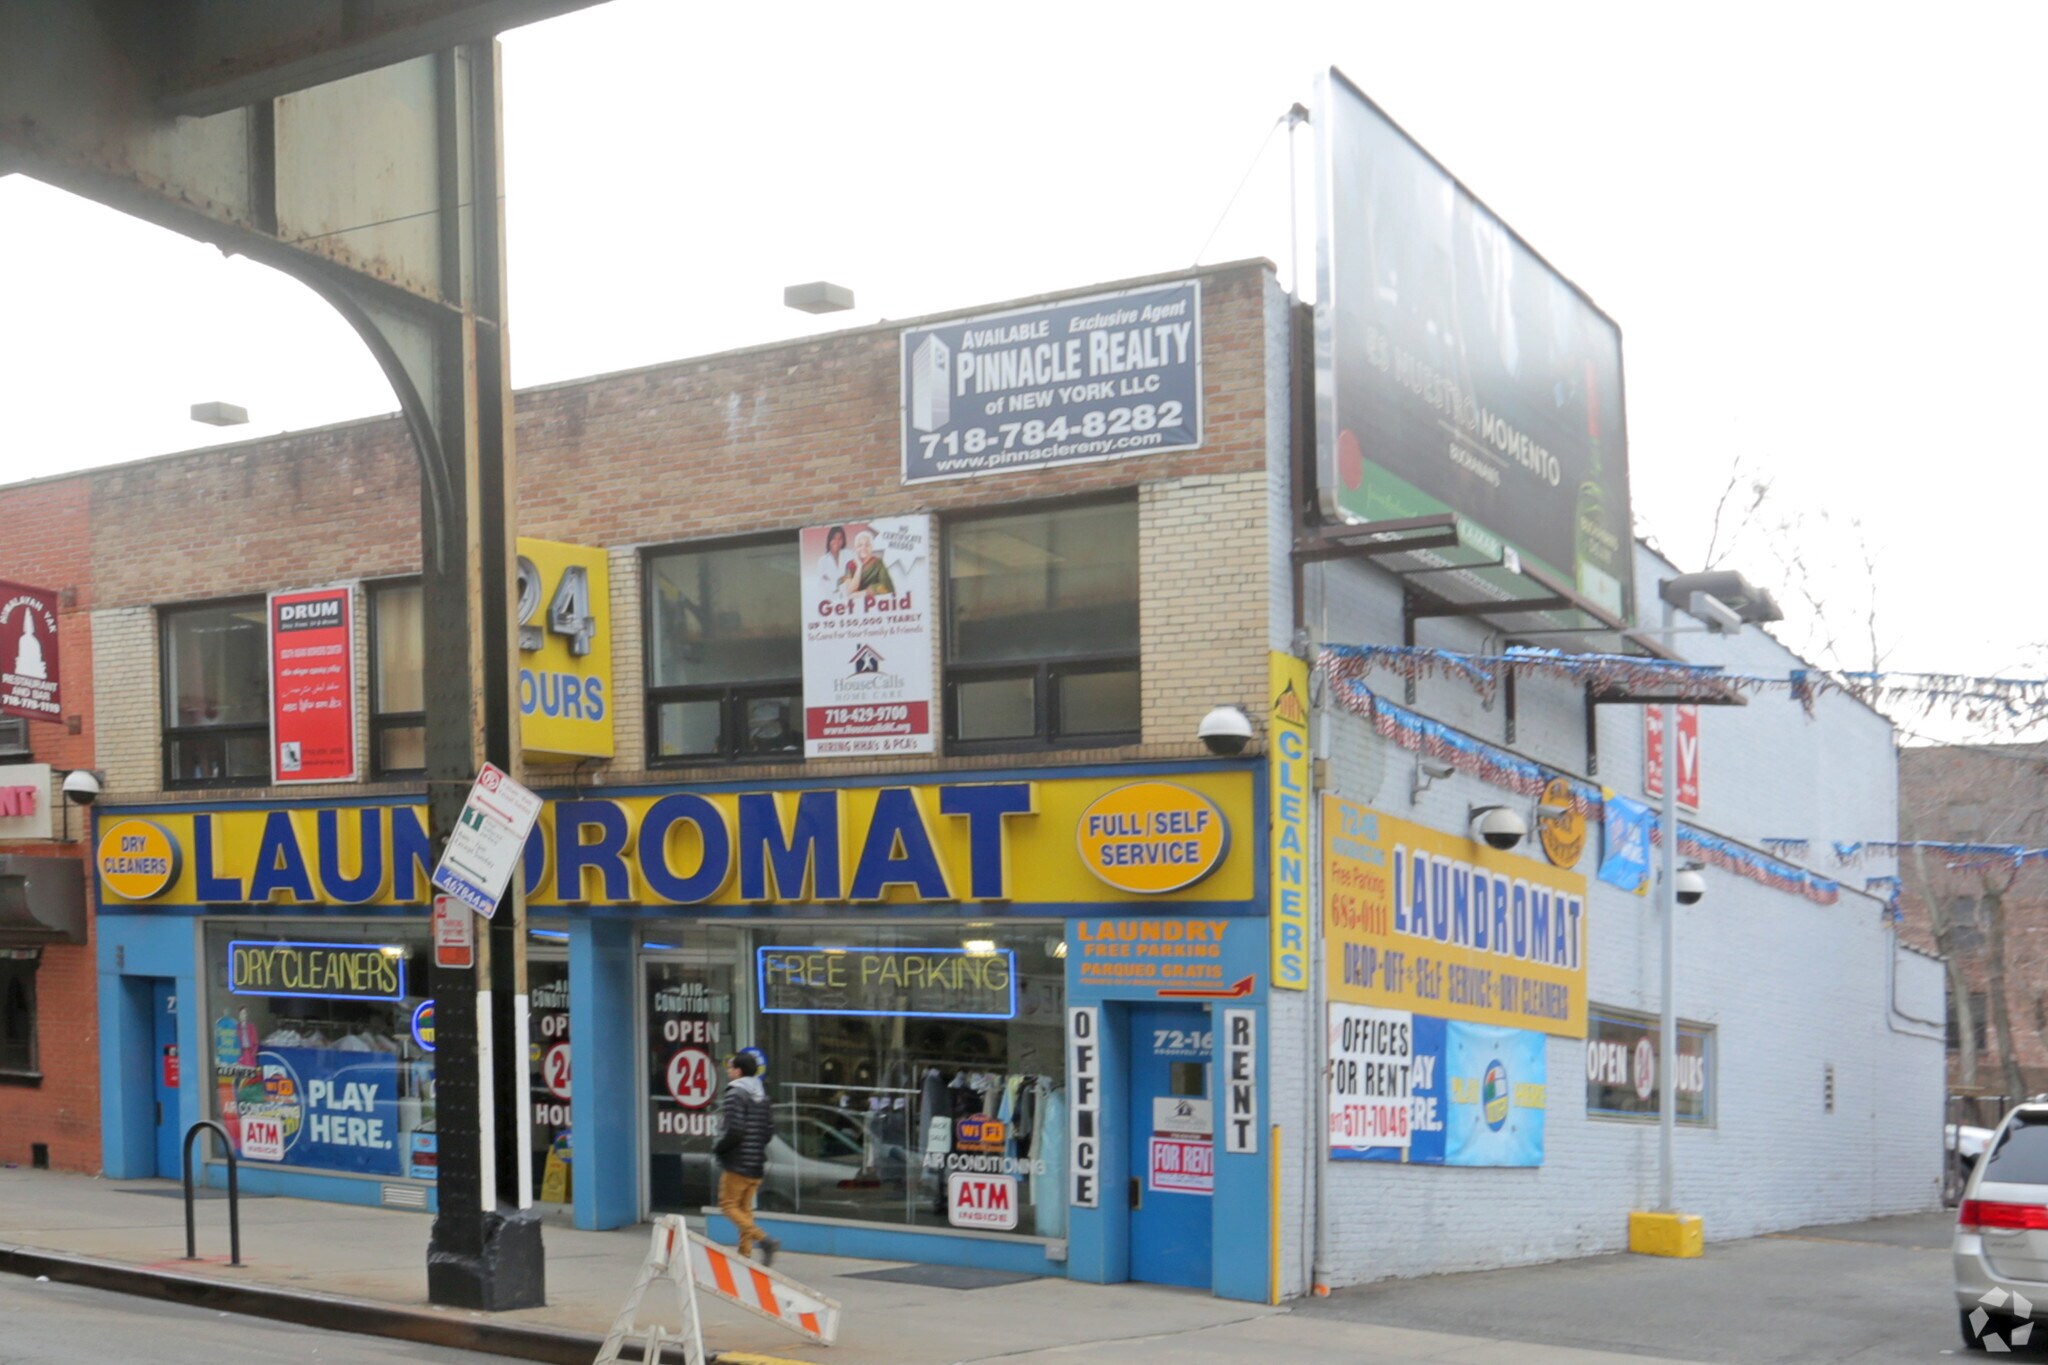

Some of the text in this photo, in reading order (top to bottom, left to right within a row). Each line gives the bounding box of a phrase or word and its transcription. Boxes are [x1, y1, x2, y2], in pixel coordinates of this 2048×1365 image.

[962, 298, 1187, 350] AVAILABLE Exclusive Agent
[956, 321, 1192, 397] PINNACLE REALTY
[985, 374, 1161, 416] of NEW YORK LLC
[919, 400, 1183, 459] 718-784-8282
[936, 431, 1162, 472] www.pinnaclereny.com
[1481, 407, 1561, 487] MOMENTO
[281, 601, 339, 621] DRUM
[517, 555, 596, 657] 24
[818, 591, 911, 617] Get Paid
[824, 620, 835, 629] TO
[887, 613, 921, 624] YEARLY
[519, 669, 604, 721] OURS
[833, 676, 905, 691] HouseCalls
[121, 835, 146, 852] DRY
[1101, 842, 1200, 866] SERVICE
[1279, 731, 1302, 982] CLEANERS
[103, 857, 167, 875] CLEANERS
[1392, 844, 1584, 971] LAUNDROMAT
[1077, 920, 1229, 942] LAUNDRY
[1084, 943, 1221, 958] FREE PARKING
[233, 949, 397, 993] DRY CLEANERS
[767, 955, 1010, 990] FREE PARKING
[1081, 962, 1223, 978] PARQUEO GRATIS
[680, 983, 703, 997] AIR
[1449, 964, 1492, 1008] SERVICE
[1500, 974, 1519, 1012] DRY
[1522, 978, 1568, 1020] CLEANERS
[664, 1020, 720, 1043] OPEN
[1153, 1030, 1213, 1049] 72-16
[1342, 1017, 1408, 1057] OFFICES
[552, 1051, 571, 1088] 2
[677, 1057, 707, 1097] 24
[1328, 1059, 1410, 1098] FOR RENT
[1411, 1055, 1435, 1089] AY
[1587, 1041, 1627, 1084] OPEN
[1672, 1054, 1703, 1092] OURS
[309, 1079, 379, 1112] PLAY
[1233, 1016, 1250, 1148] RENT
[658, 1111, 724, 1136] HOUR
[1075, 1011, 1093, 1203] OFFICE
[1344, 1105, 1408, 1137] 577-7046
[1410, 1097, 1443, 1131] ERE.
[247, 1122, 278, 1145] ATM
[310, 1114, 392, 1150] HERE.
[923, 1152, 1046, 1175] AIR CONDITIONING
[1155, 1144, 1180, 1172] FOR
[957, 1181, 1008, 1210] ATM
[958, 1211, 1007, 1222] INSIDE
